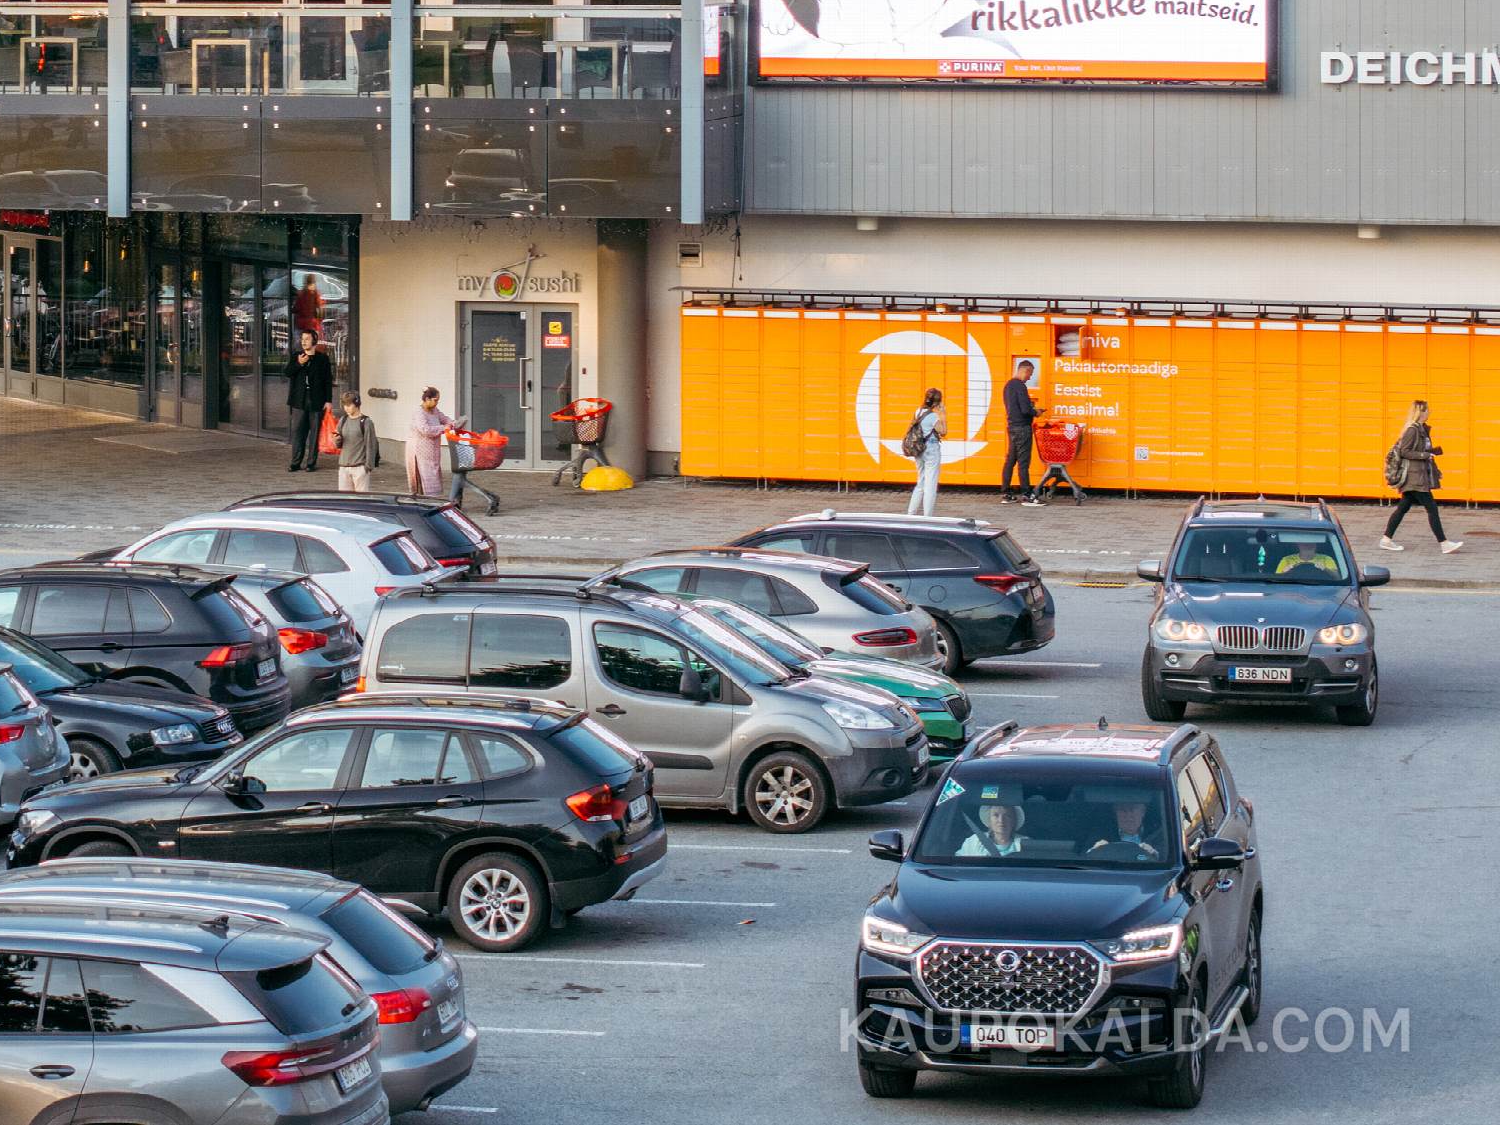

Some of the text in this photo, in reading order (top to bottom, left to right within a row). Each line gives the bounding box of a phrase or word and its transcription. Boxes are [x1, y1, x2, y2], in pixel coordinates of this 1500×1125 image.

[954, 62, 1002, 72] PURINA
[458, 270, 581, 297] my sushi
[1054, 359, 1178, 378] Pakiautomaadiga
[1262, 669, 1287, 680] NDN
[977, 1027, 1048, 1044] 040 TOP
